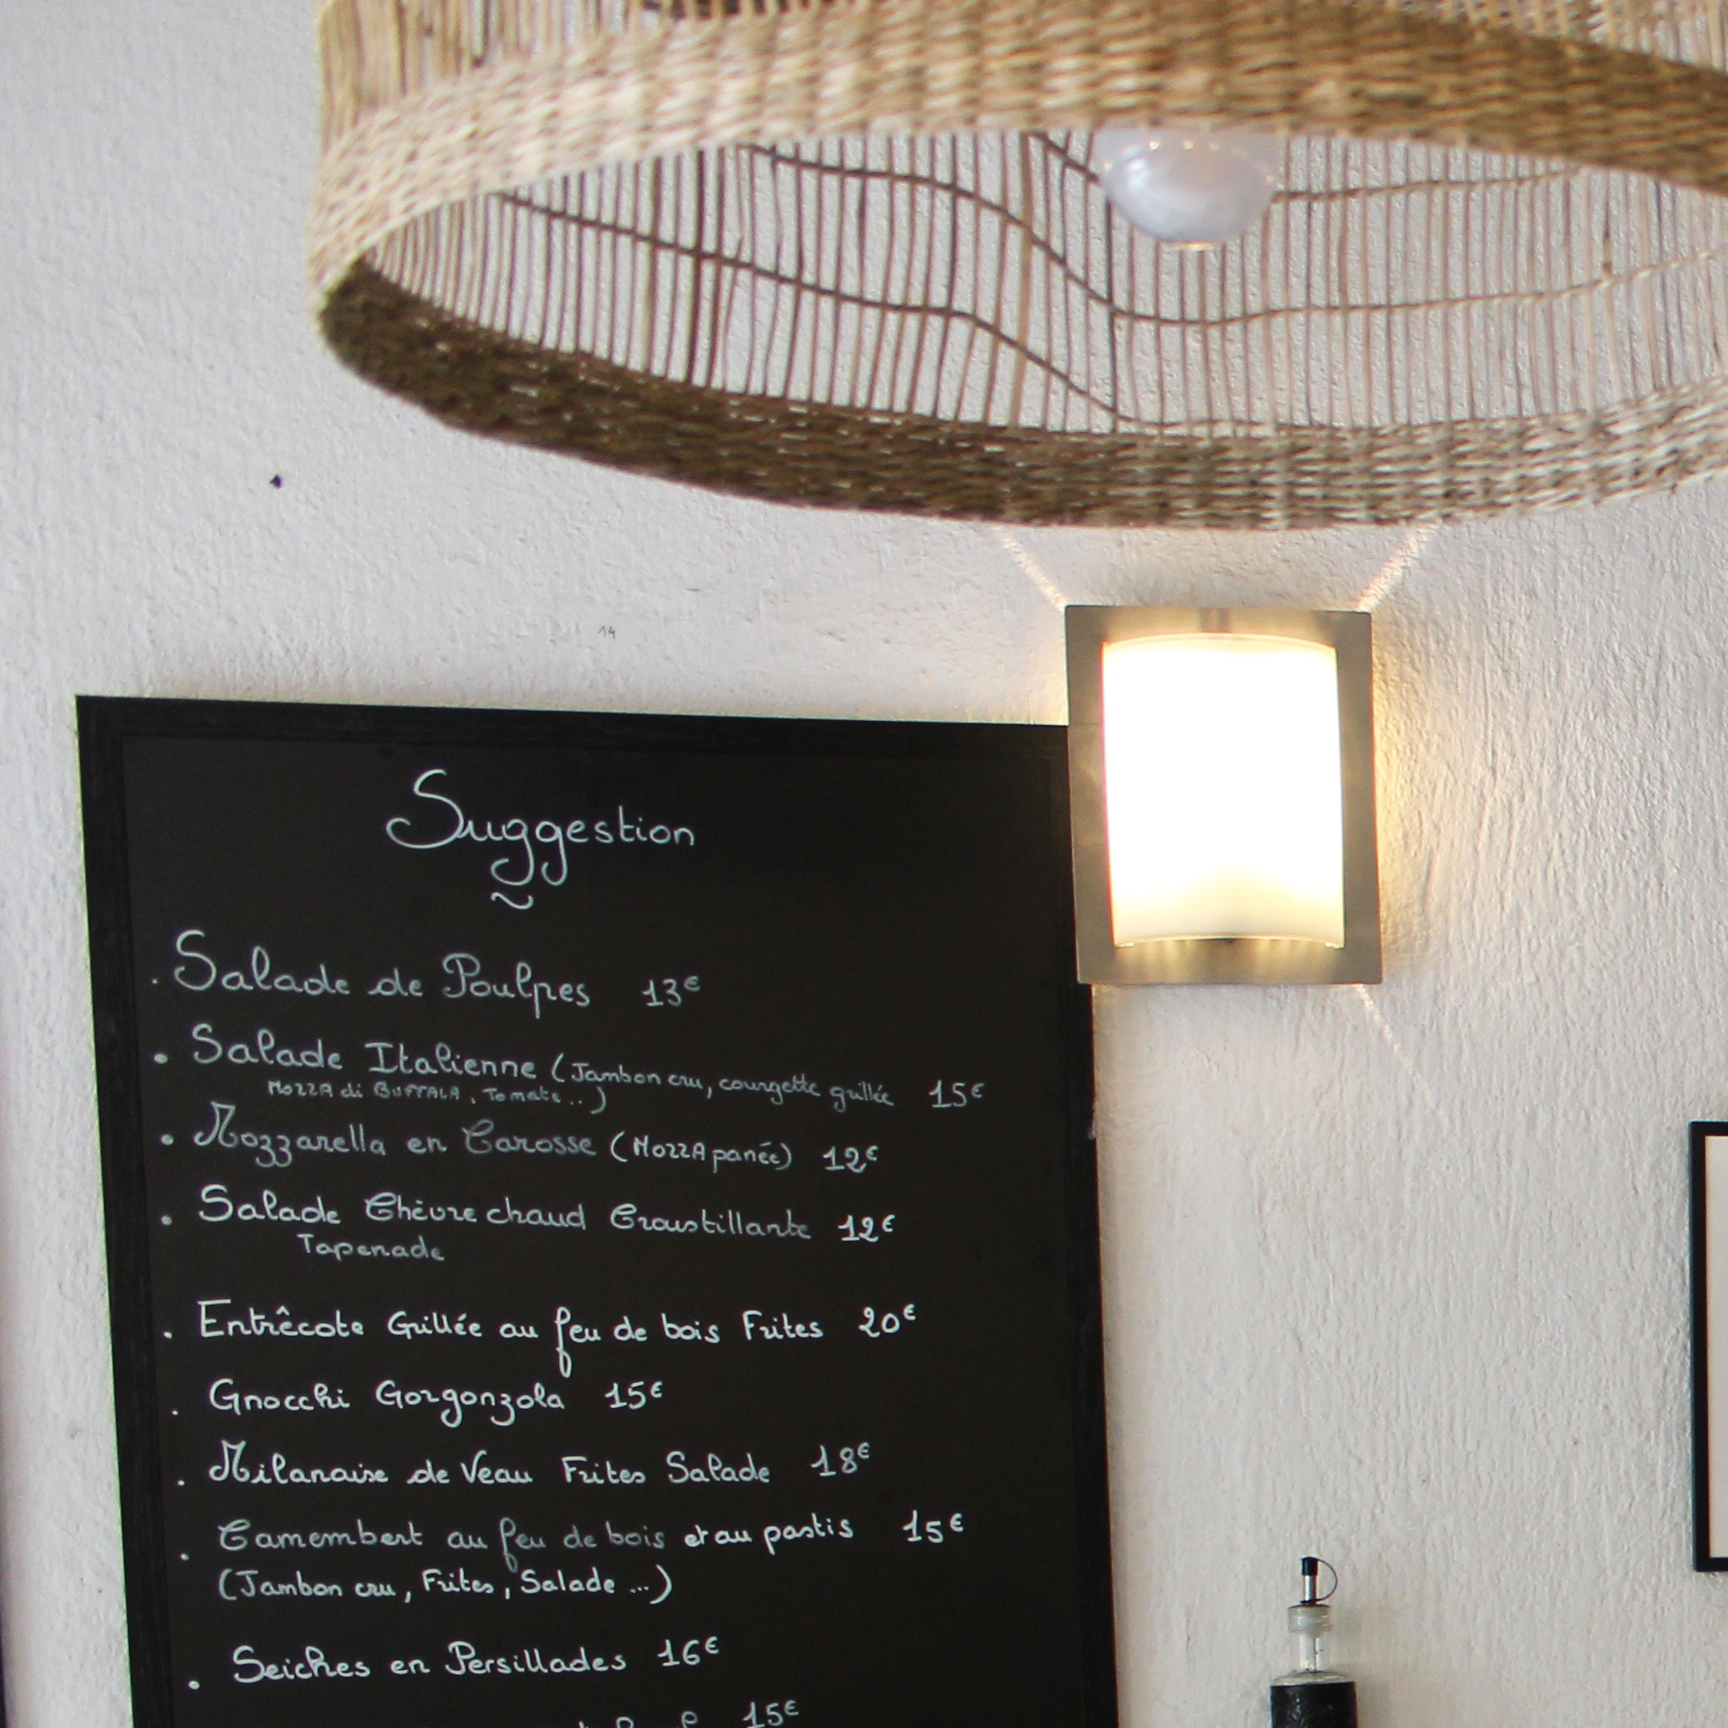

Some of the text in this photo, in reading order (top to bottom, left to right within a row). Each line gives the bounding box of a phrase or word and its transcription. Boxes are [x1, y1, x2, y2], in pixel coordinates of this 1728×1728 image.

[386, 768, 694, 886] Suggestion
[174, 929, 700, 1019] Salade de Poulpes 13€
[192, 1023, 343, 1071] Salade
[364, 1042, 537, 1079] Italienne
[719, 1073, 821, 1105] courgette
[929, 1079, 985, 1108] 15€
[340, 1083, 363, 1099] di
[193, 1101, 386, 1167] Mozzarella
[407, 1135, 447, 1154] en
[462, 1119, 597, 1156] Carosse
[712, 1142, 792, 1173] panée)
[822, 1145, 879, 1173] 12€
[199, 1184, 895, 1242] Salade Chèvre chaud Croustillante 12€
[297, 1234, 445, 1261] Tapenade
[197, 1298, 916, 1378] Entrêcote Grillée au feu de bois Frites 20€
[208, 1378, 663, 1428] Gnocchi Gorgonzola 15€
[208, 1440, 870, 1485] Milanaise de Veau Frites Salade 18€
[218, 1519, 423, 1551] Camembert
[447, 1532, 488, 1550] au
[500, 1517, 546, 1573] feu
[563, 1524, 597, 1549] de
[605, 1521, 665, 1550] bois
[714, 1528, 753, 1544] au
[763, 1512, 854, 1555] pastis
[902, 1510, 963, 1543] 15€
[218, 1568, 343, 1600] (Jambon
[233, 1636, 720, 1684] Seiches en Persillades 16€
